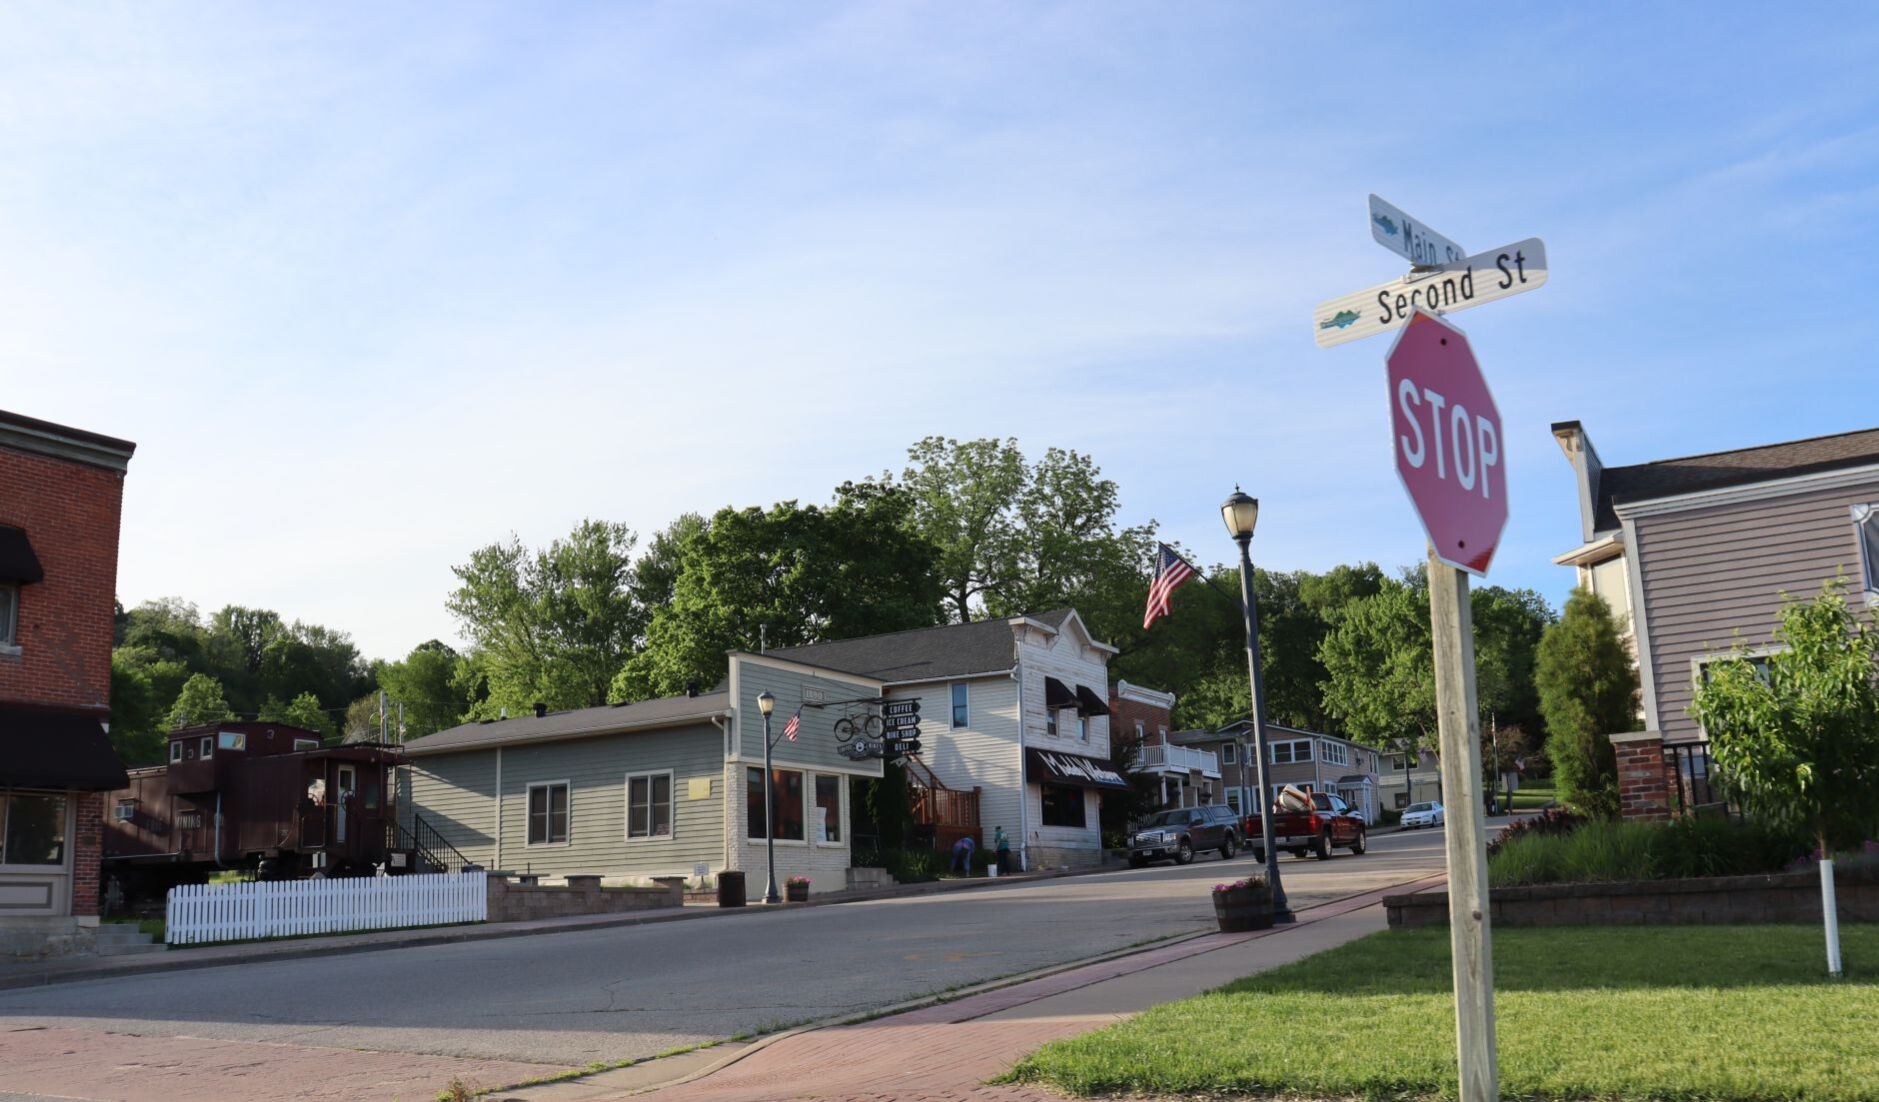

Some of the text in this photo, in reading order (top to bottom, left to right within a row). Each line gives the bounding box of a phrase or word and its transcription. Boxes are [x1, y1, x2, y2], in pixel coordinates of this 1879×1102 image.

[1402, 219, 1437, 265] Main
[1378, 251, 1528, 324] Second St
[1399, 378, 1498, 499] STOP
[889, 704, 913, 714] COFFEE
[886, 716, 916, 727] ICE CREAM
[267, 729, 274, 740] 3
[886, 728, 917, 739] BIKE SHOP
[895, 742, 909, 752] DELI
